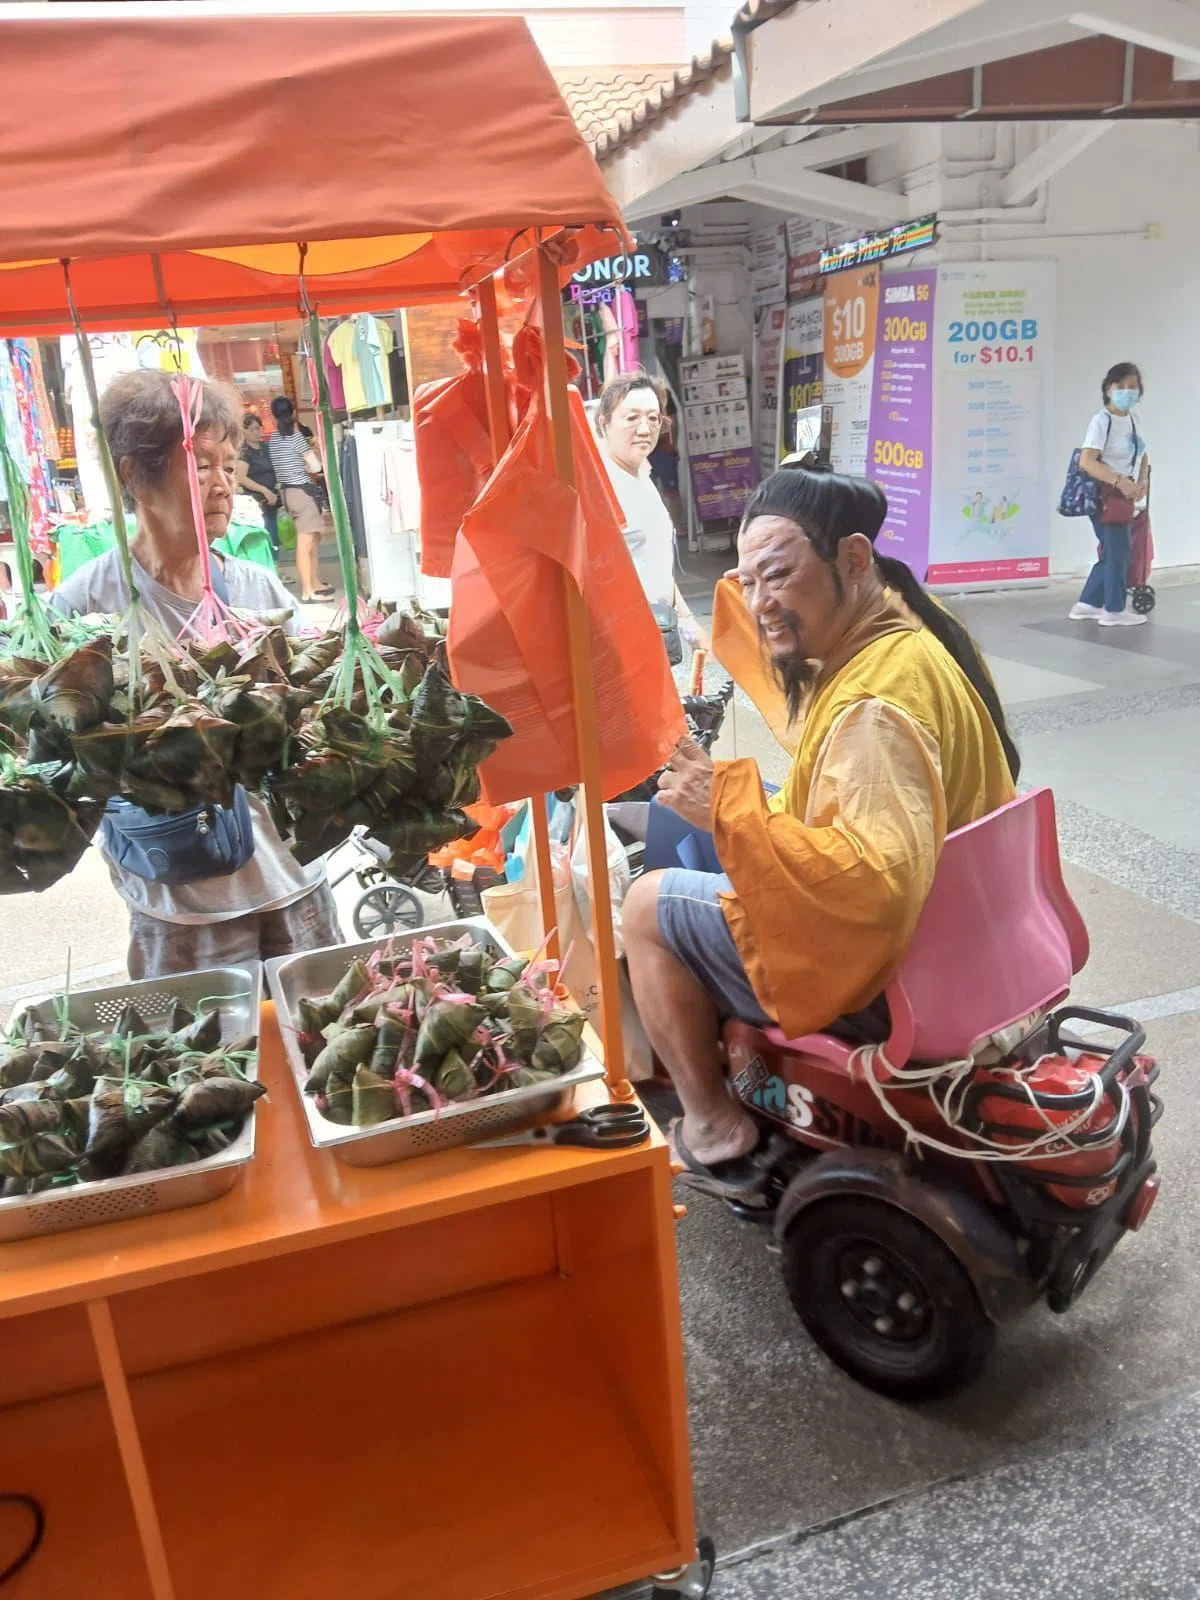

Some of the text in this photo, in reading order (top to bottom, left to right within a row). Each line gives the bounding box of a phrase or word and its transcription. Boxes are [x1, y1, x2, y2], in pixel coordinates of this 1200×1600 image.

[831, 296, 866, 339] $10
[883, 316, 927, 342] 300GB
[948, 319, 1038, 342] 200GB
[953, 345, 1034, 364] for $10.1
[874, 439, 924, 469] 500GB
